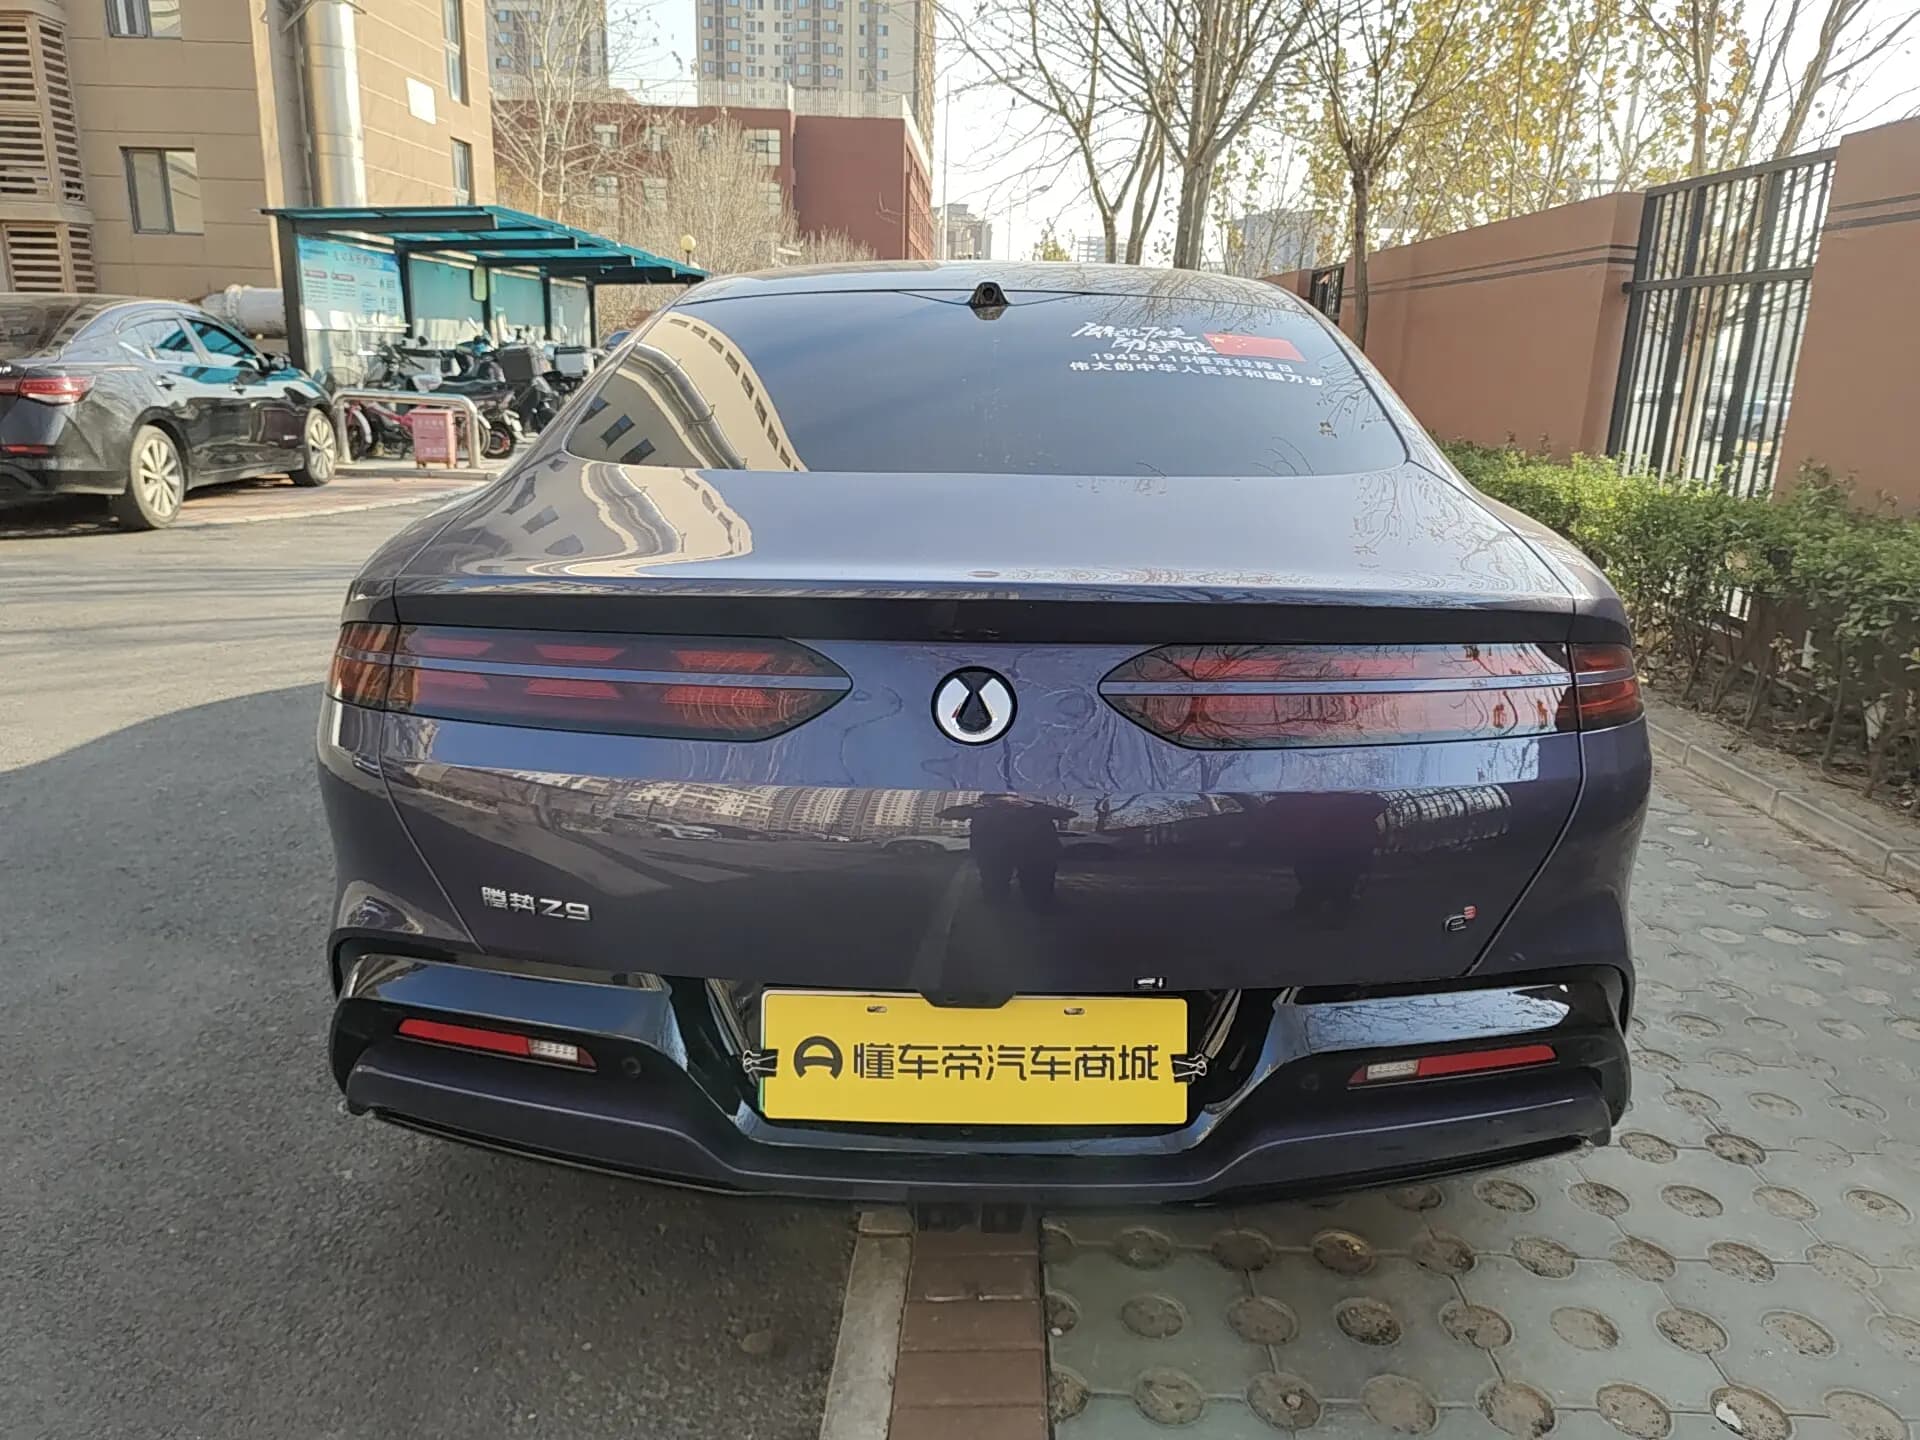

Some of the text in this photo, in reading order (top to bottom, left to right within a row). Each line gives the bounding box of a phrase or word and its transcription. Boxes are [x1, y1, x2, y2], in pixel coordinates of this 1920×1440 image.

[1069, 361, 1323, 387] 伟大的中华人民共和国万岁
[853, 1043, 1160, 1082] 懂车帝汽车商城
